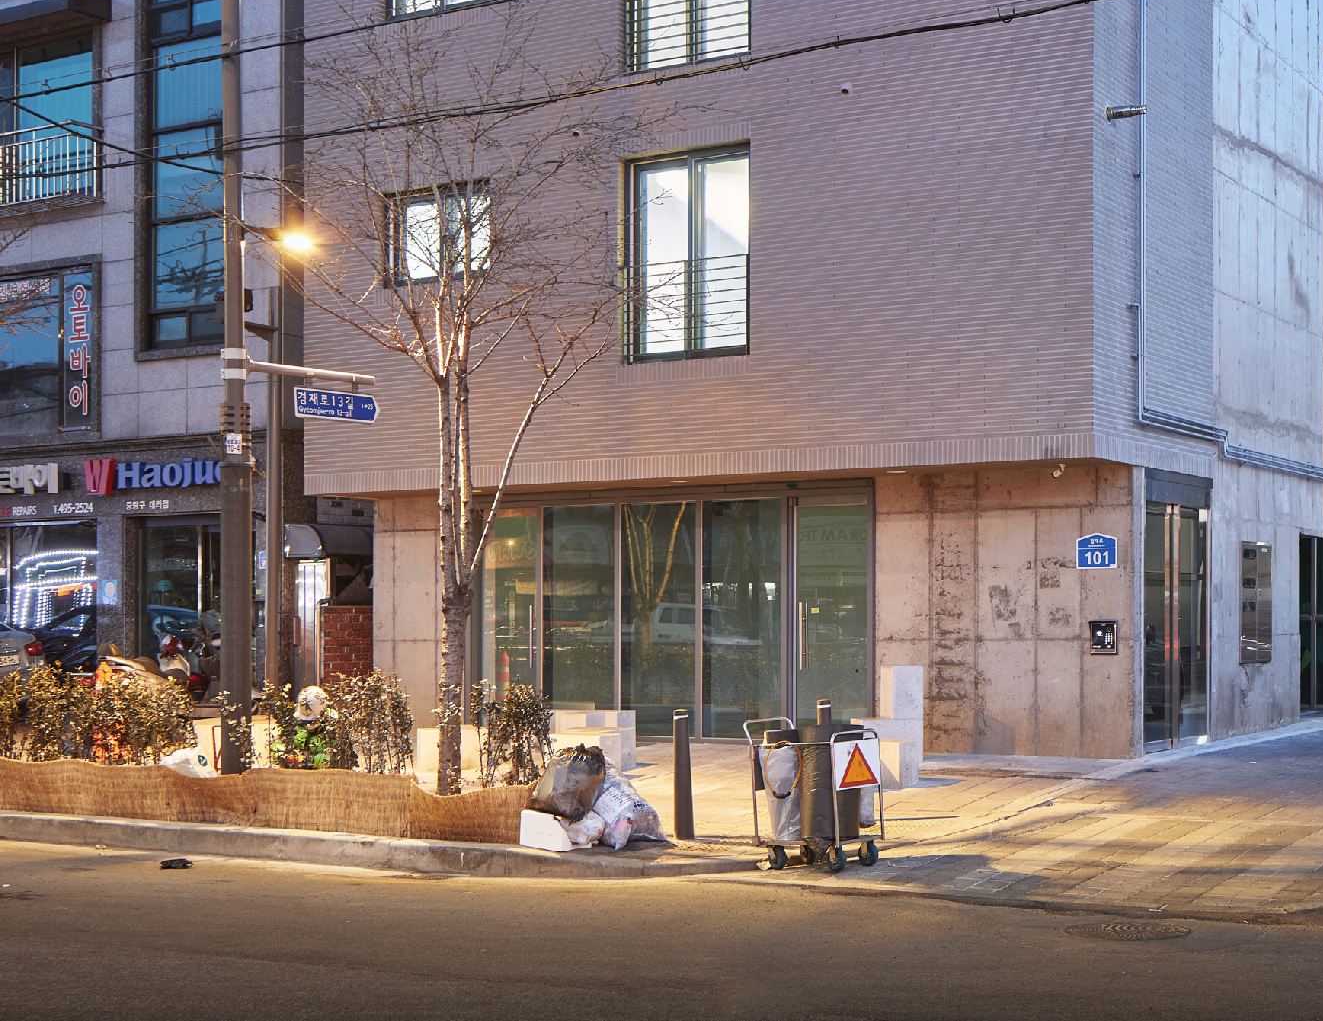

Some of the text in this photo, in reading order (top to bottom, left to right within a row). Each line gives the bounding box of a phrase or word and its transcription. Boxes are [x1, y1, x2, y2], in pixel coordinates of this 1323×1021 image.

[68, 284, 91, 416] 오토바이
[297, 391, 354, 410] 겸재로13길
[12, 505, 37, 516] REPAIRS
[53, 502, 94, 514] T.495-2524
[149, 499, 170, 509] 대리점
[1085, 551, 1109, 565] 101
